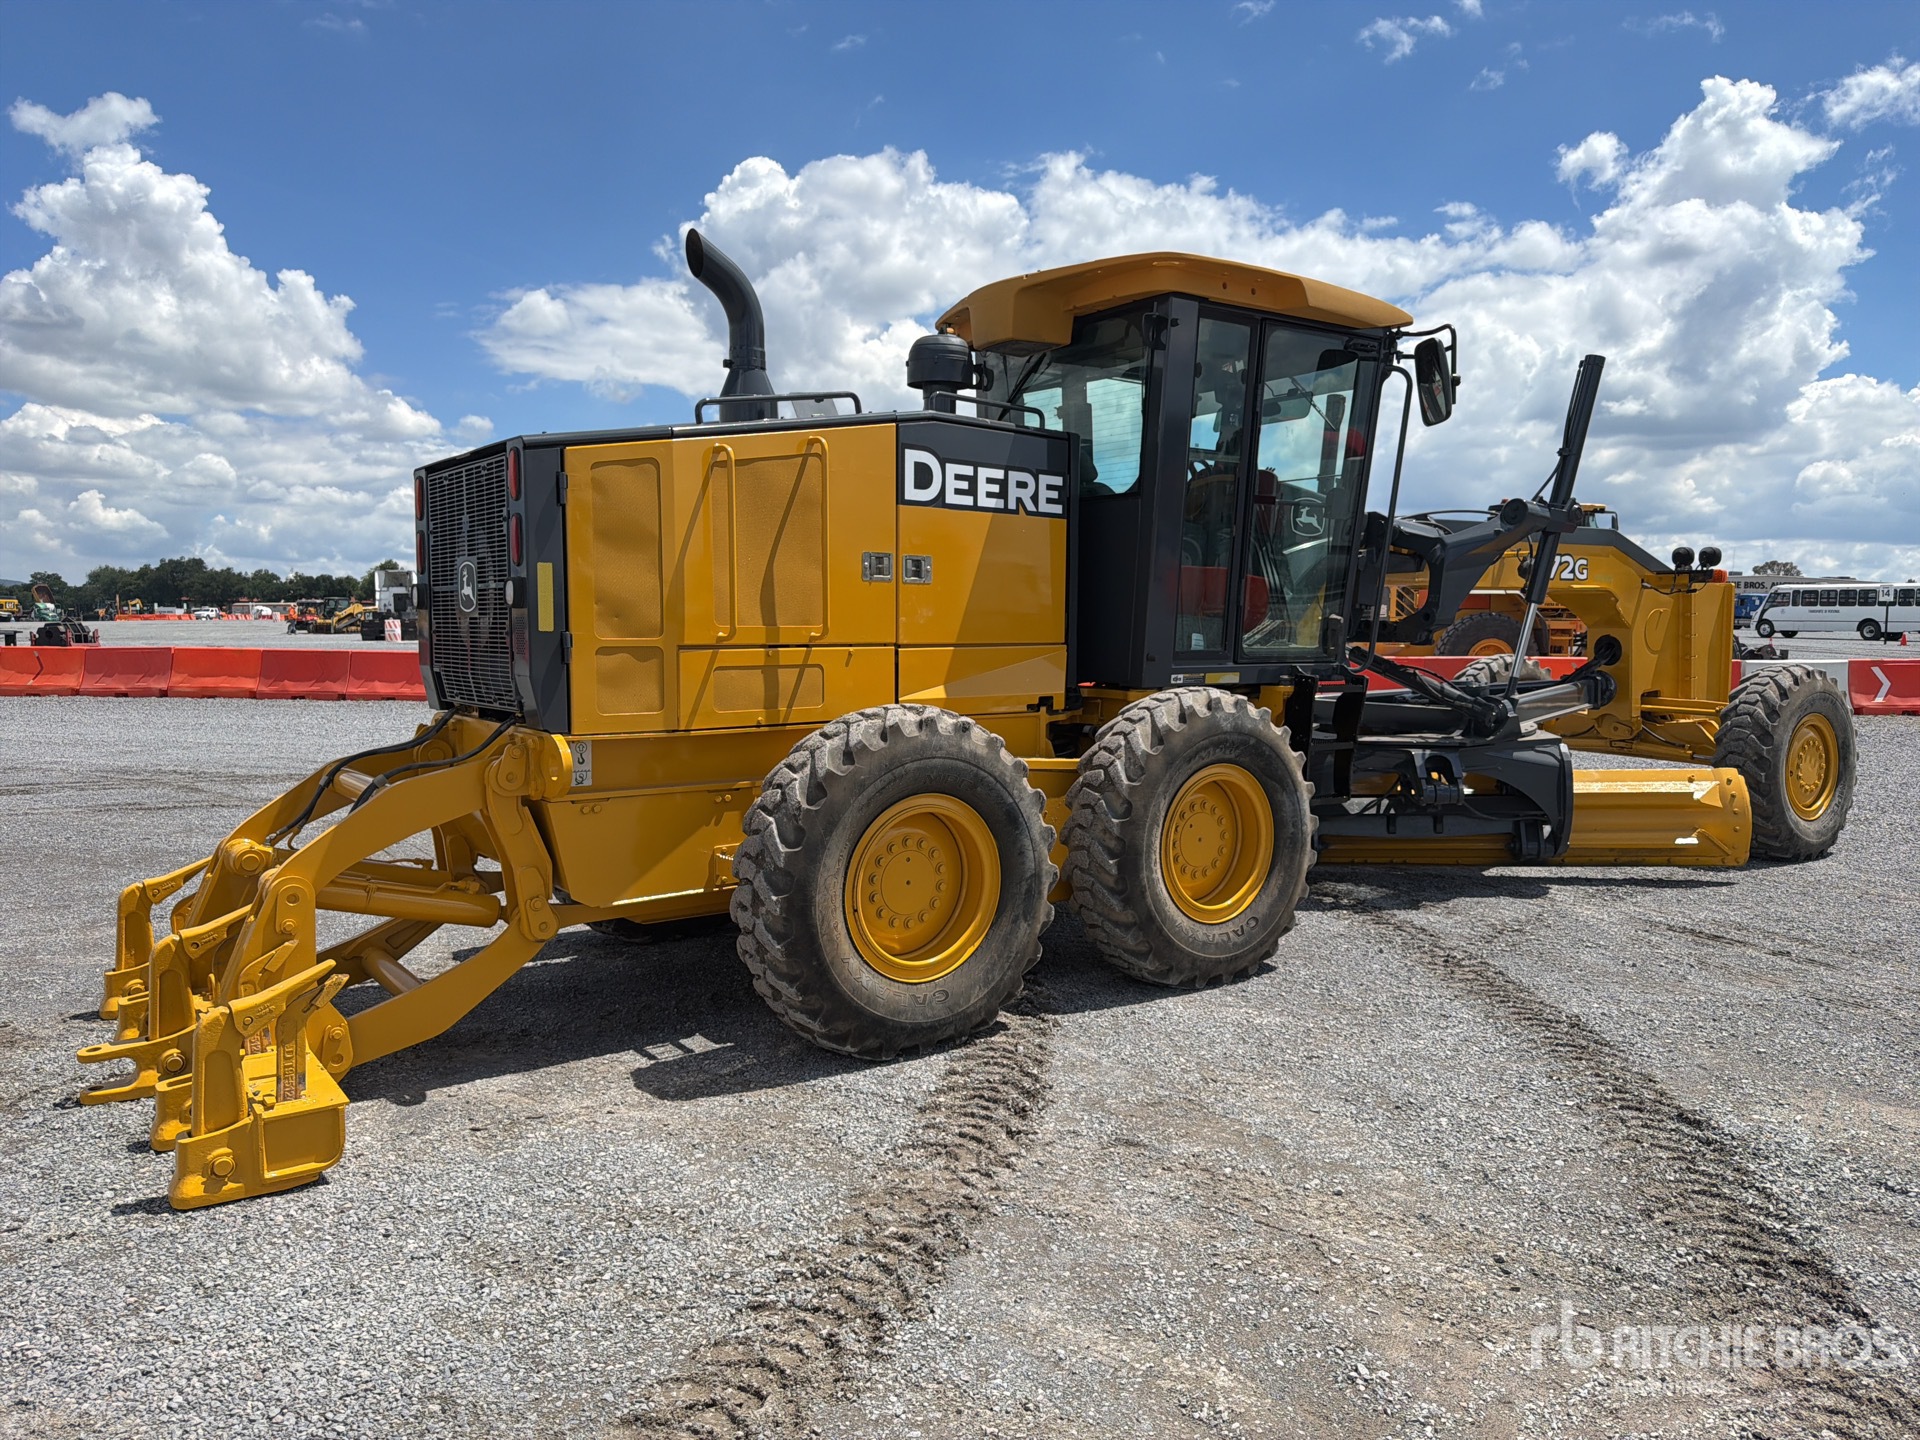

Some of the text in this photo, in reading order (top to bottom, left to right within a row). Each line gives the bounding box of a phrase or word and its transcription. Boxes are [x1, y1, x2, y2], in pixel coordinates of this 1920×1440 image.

[904, 448, 1064, 514] DEERE
[1743, 581, 1768, 590] BROS.
[1881, 589, 1890, 597] 14
[841, 957, 950, 1008] GALAXY
